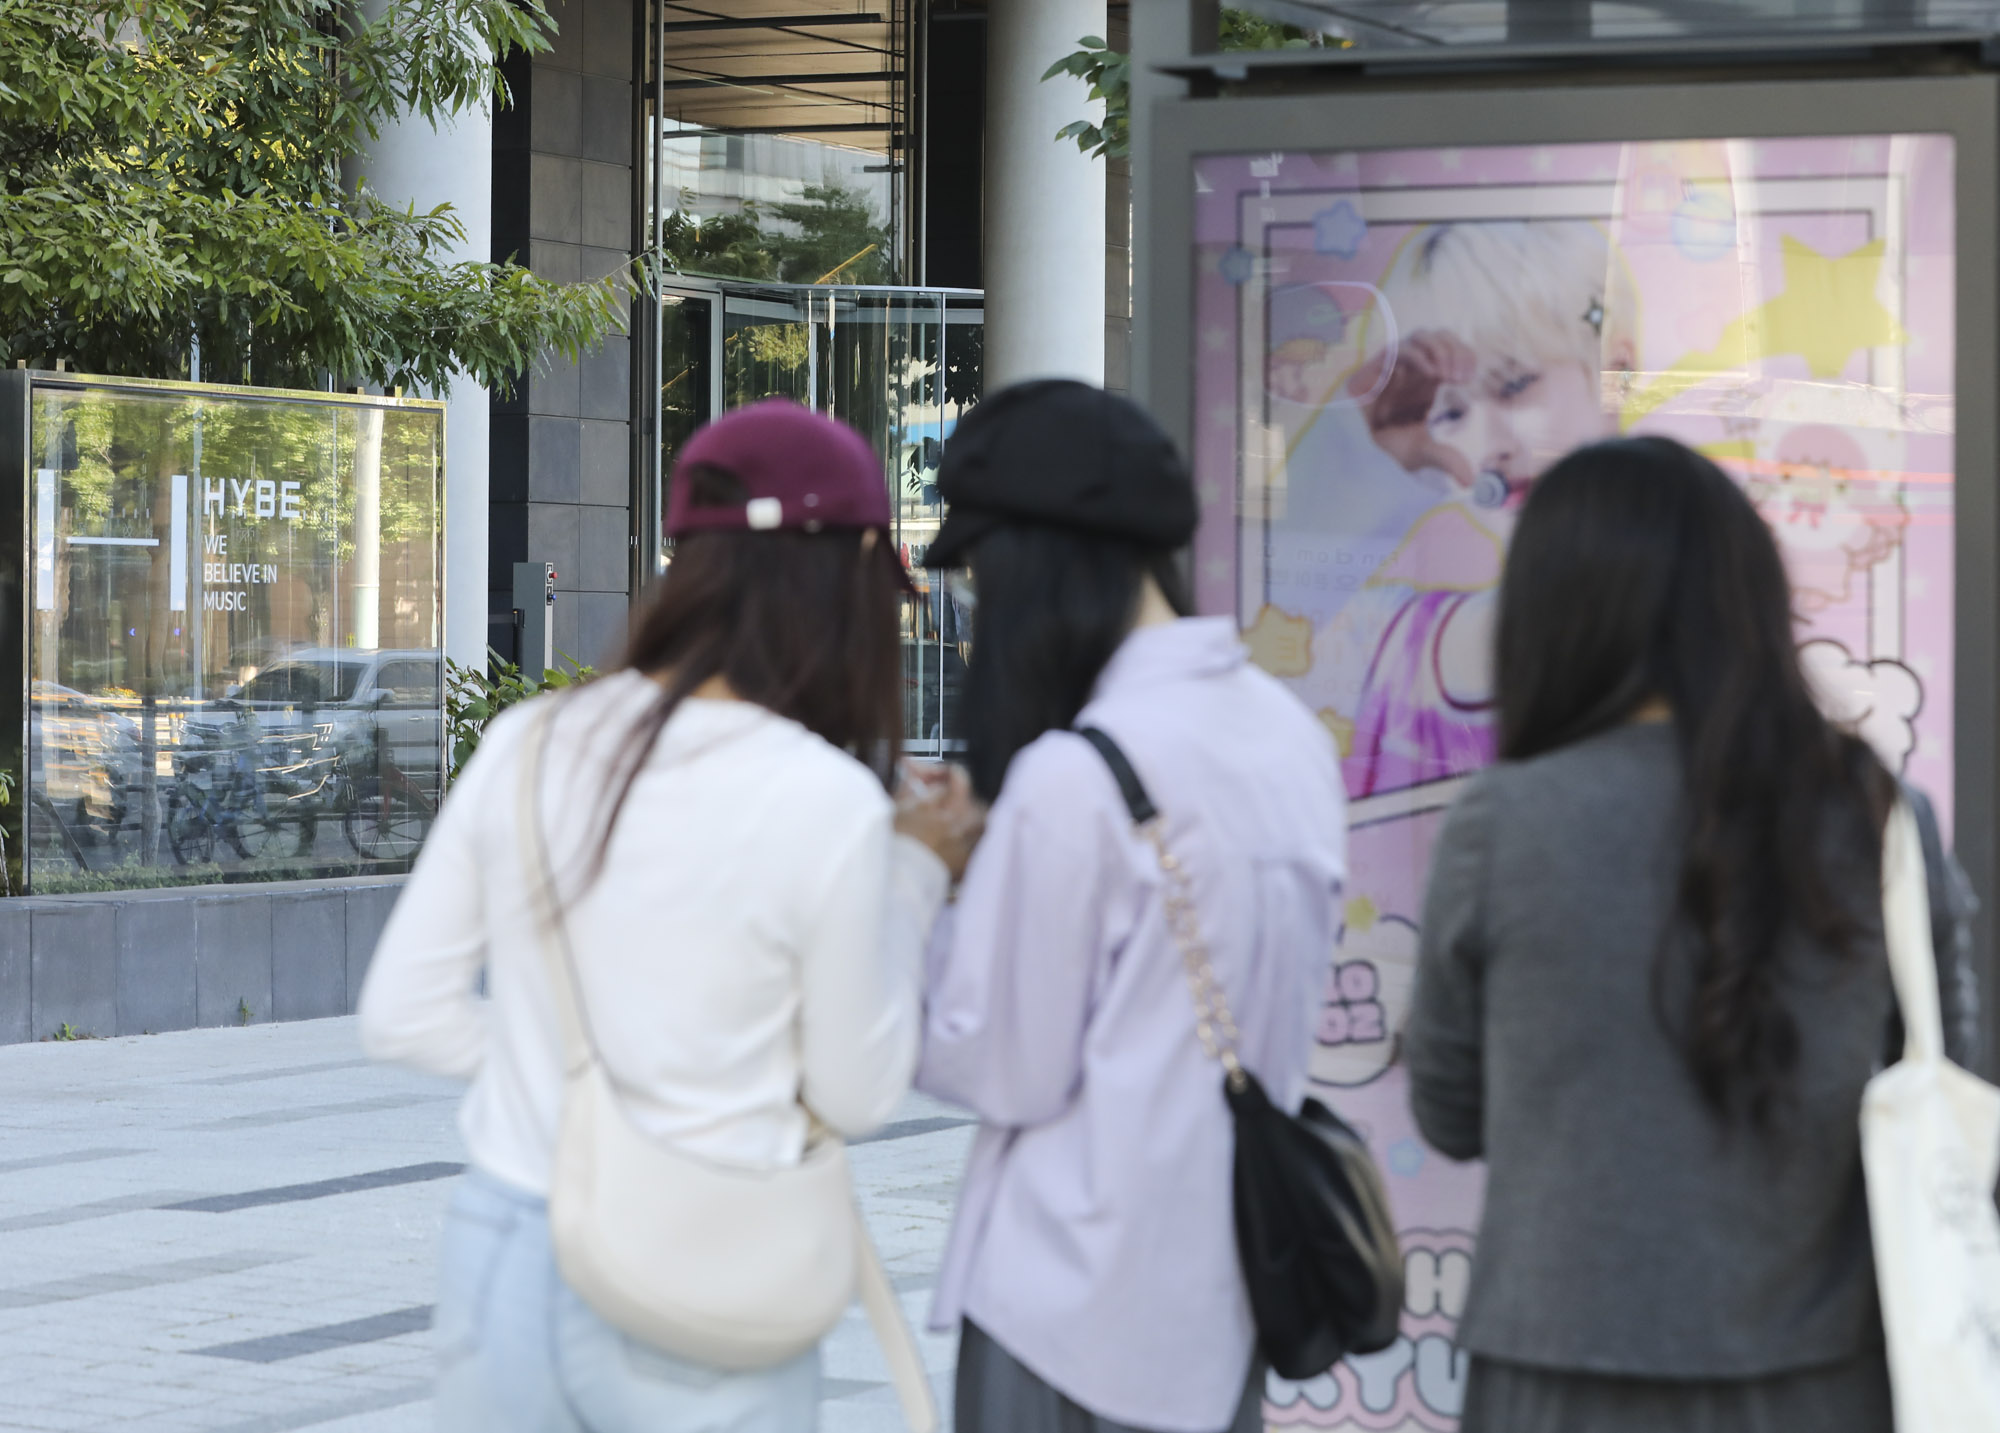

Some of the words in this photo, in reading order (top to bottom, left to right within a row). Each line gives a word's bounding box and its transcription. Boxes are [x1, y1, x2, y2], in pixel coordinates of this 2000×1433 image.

[203, 477, 301, 518] HYBE
[204, 535, 227, 555] WE
[204, 563, 261, 584] BELIEVE
[264, 564, 278, 583] IN
[204, 591, 247, 611] MUSIC
